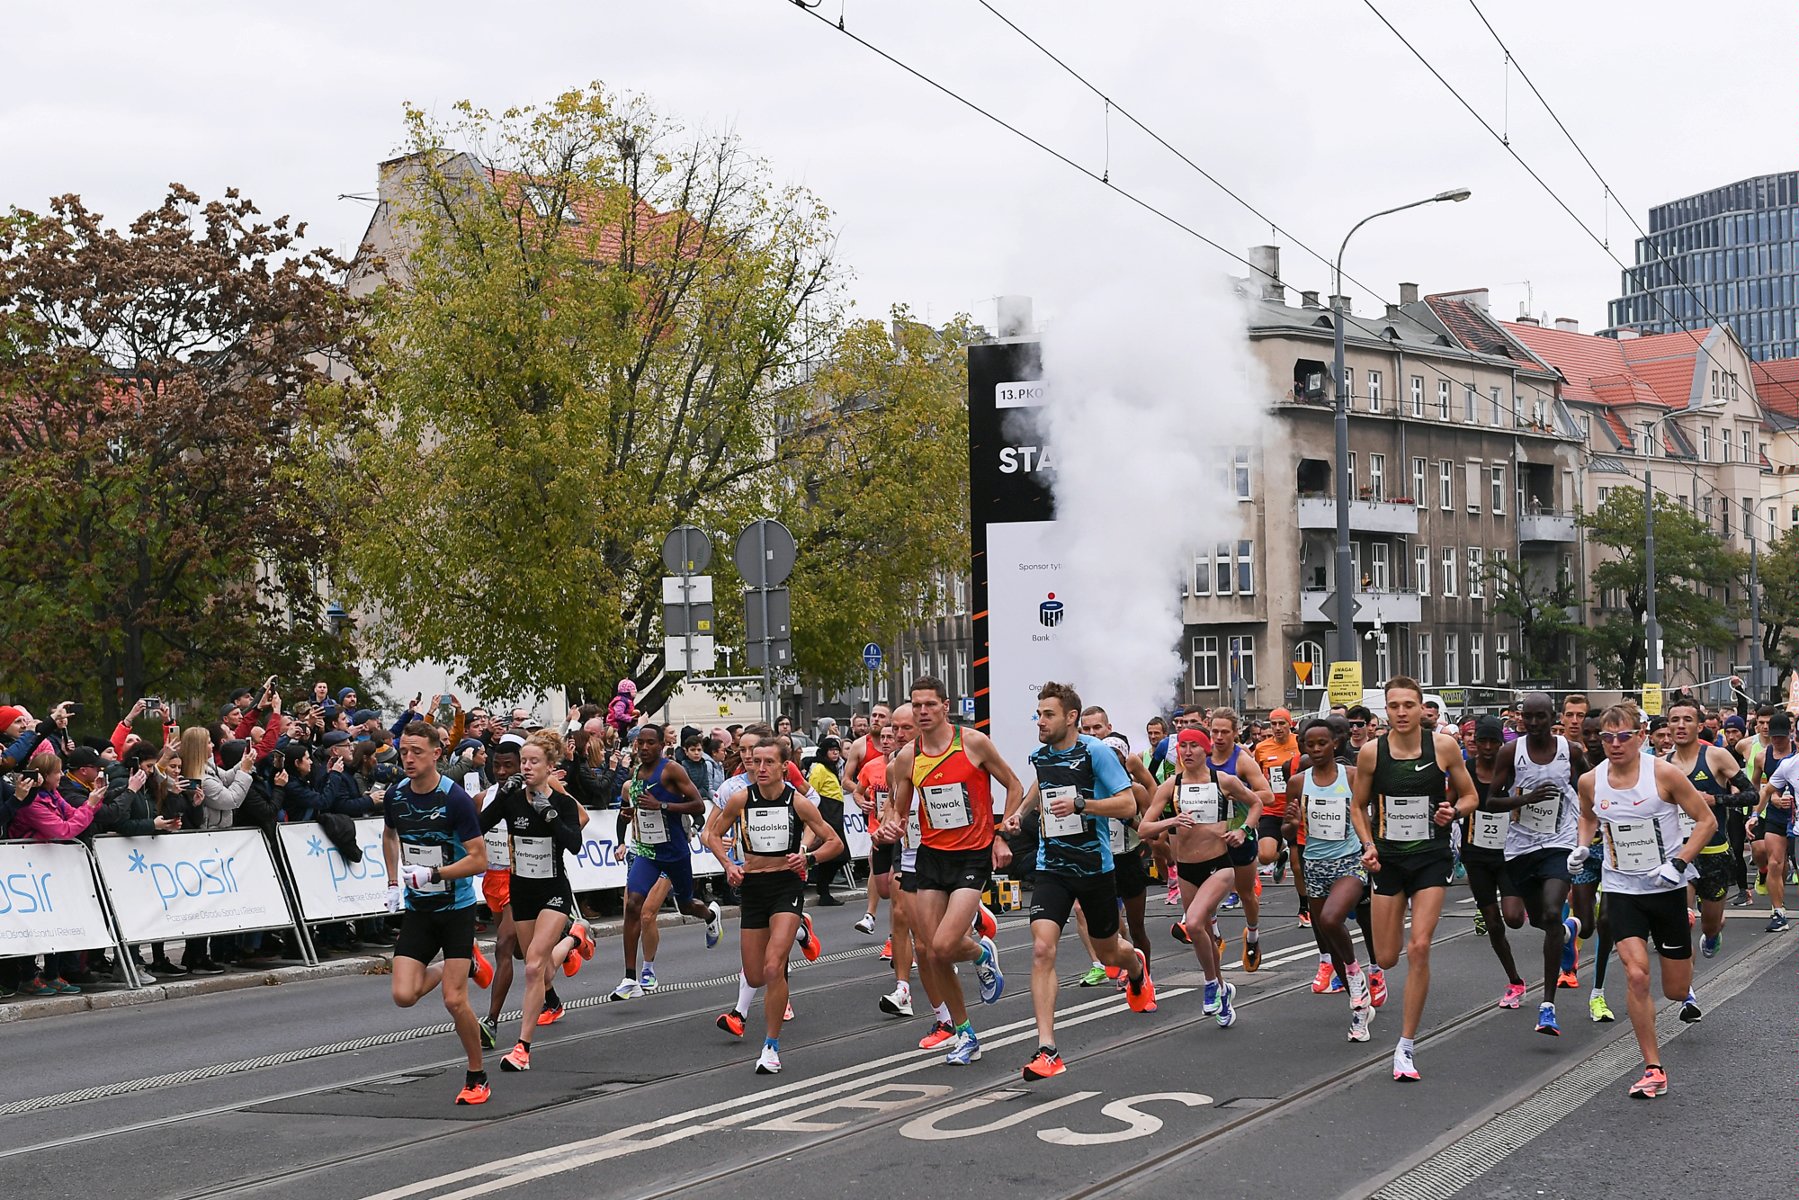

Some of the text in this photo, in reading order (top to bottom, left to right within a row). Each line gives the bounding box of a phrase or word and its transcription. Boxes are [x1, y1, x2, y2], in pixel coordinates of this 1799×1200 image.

[1019, 563, 1049, 571] Sponsor
[1032, 634, 1050, 642] Bank
[965, 700, 975, 712] P
[930, 800, 961, 810] Nowak
[1526, 803, 1554, 817] Maiyo
[1311, 811, 1341, 821] Gichia
[1387, 812, 1428, 820] Karbowiak
[642, 821, 655, 829] Esa
[749, 824, 788, 832] Nadolska
[1483, 824, 1499, 834] 23
[515, 850, 552, 861] Verbruggen
[743, 1083, 1214, 1146] BUS
